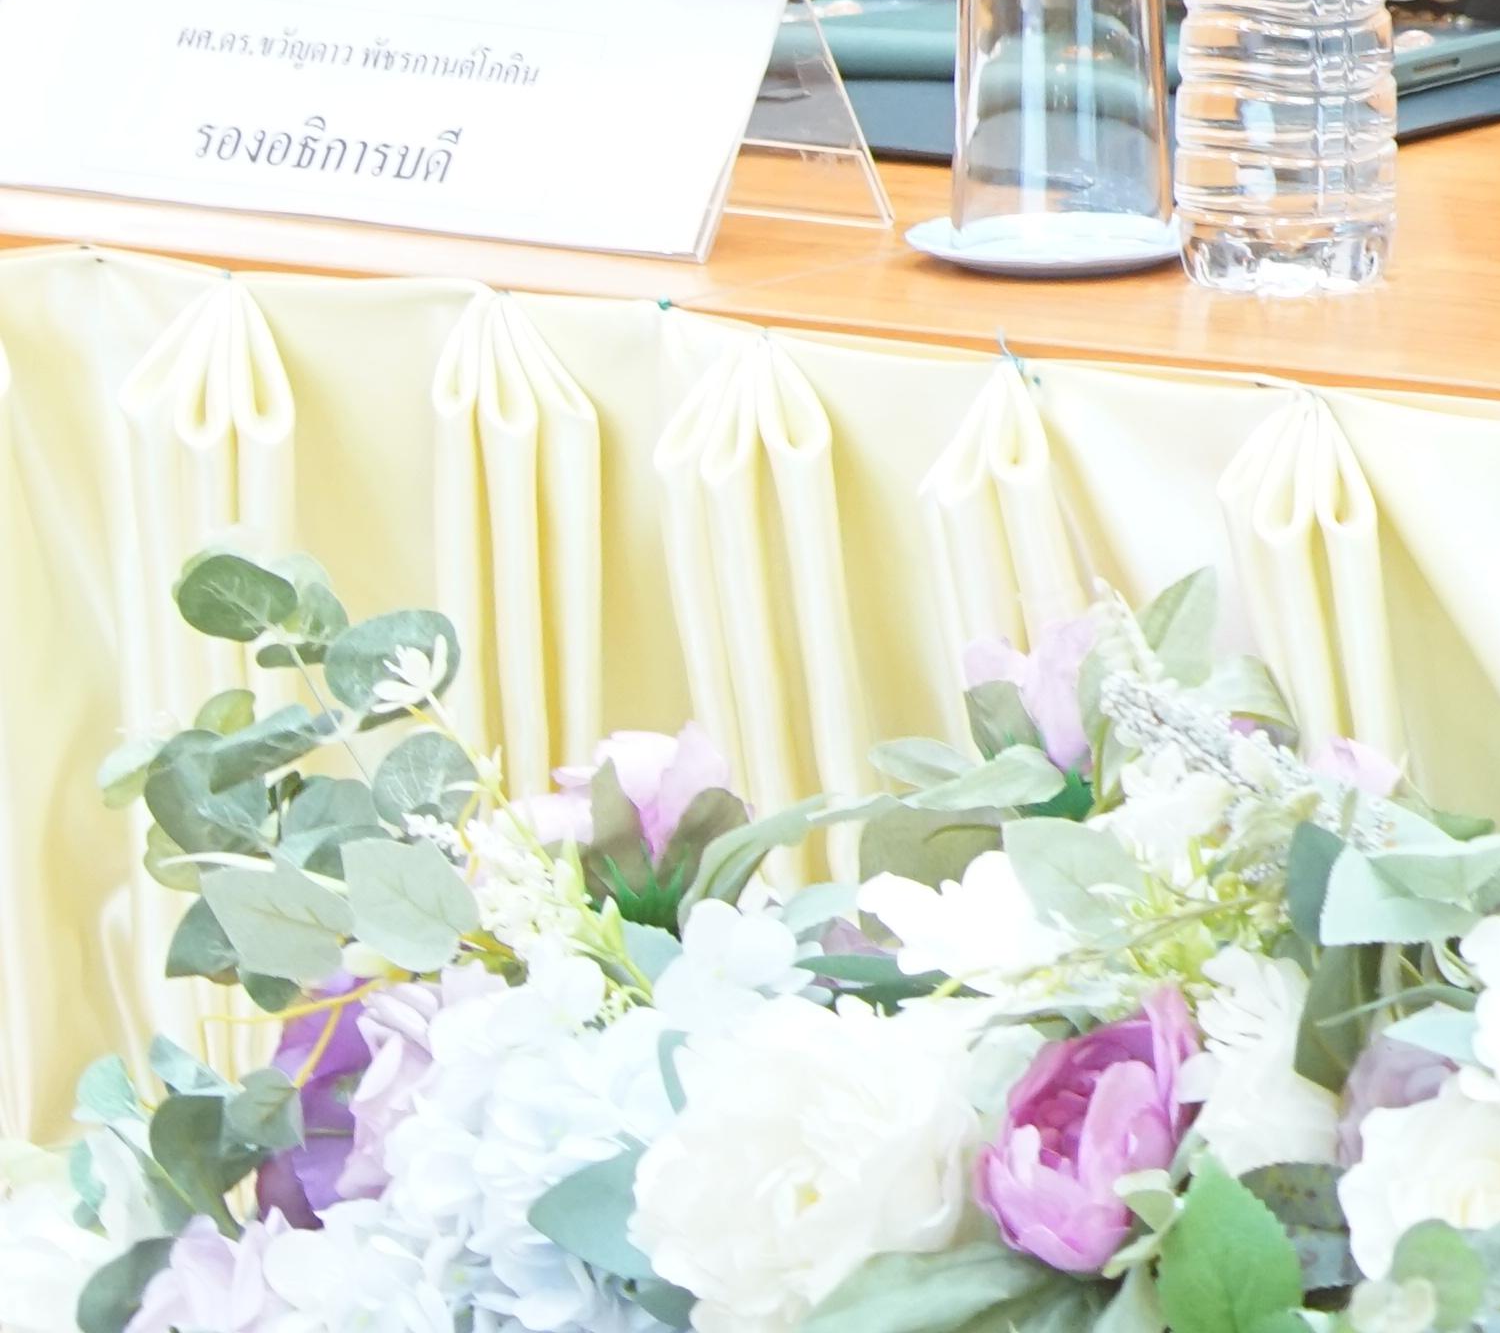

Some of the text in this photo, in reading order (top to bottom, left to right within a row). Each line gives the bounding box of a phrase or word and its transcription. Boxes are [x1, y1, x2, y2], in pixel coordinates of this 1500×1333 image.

[195, 115, 464, 184] รองอธิการบดี
